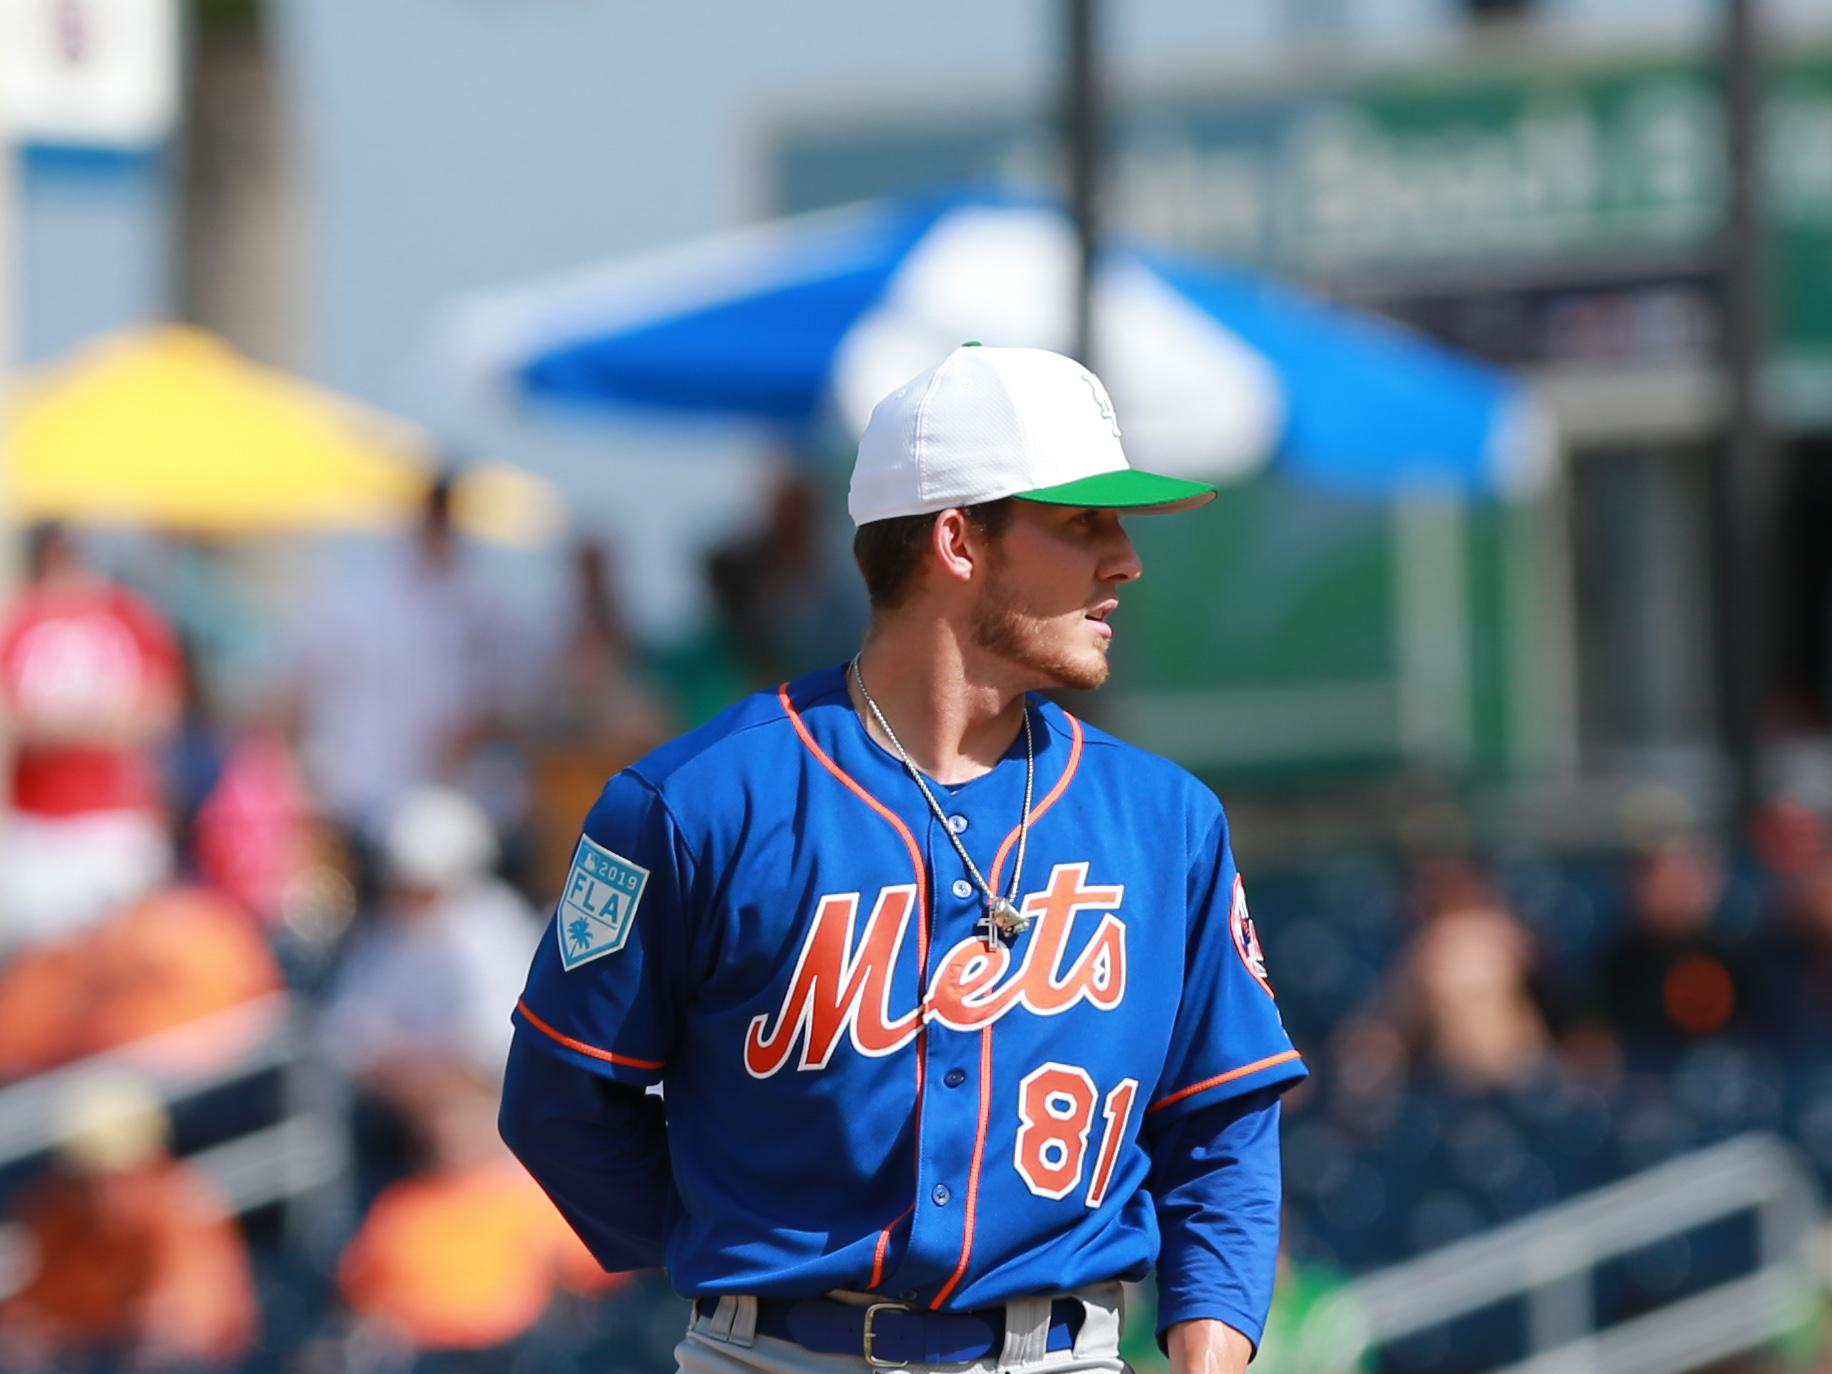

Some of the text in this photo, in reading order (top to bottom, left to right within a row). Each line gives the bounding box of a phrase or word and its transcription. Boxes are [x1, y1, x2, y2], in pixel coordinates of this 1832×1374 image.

[570, 872, 622, 924] FLA
[598, 862, 638, 890] 2019
[745, 861, 1126, 1079] Mets
[1014, 1062, 1140, 1208] 81
